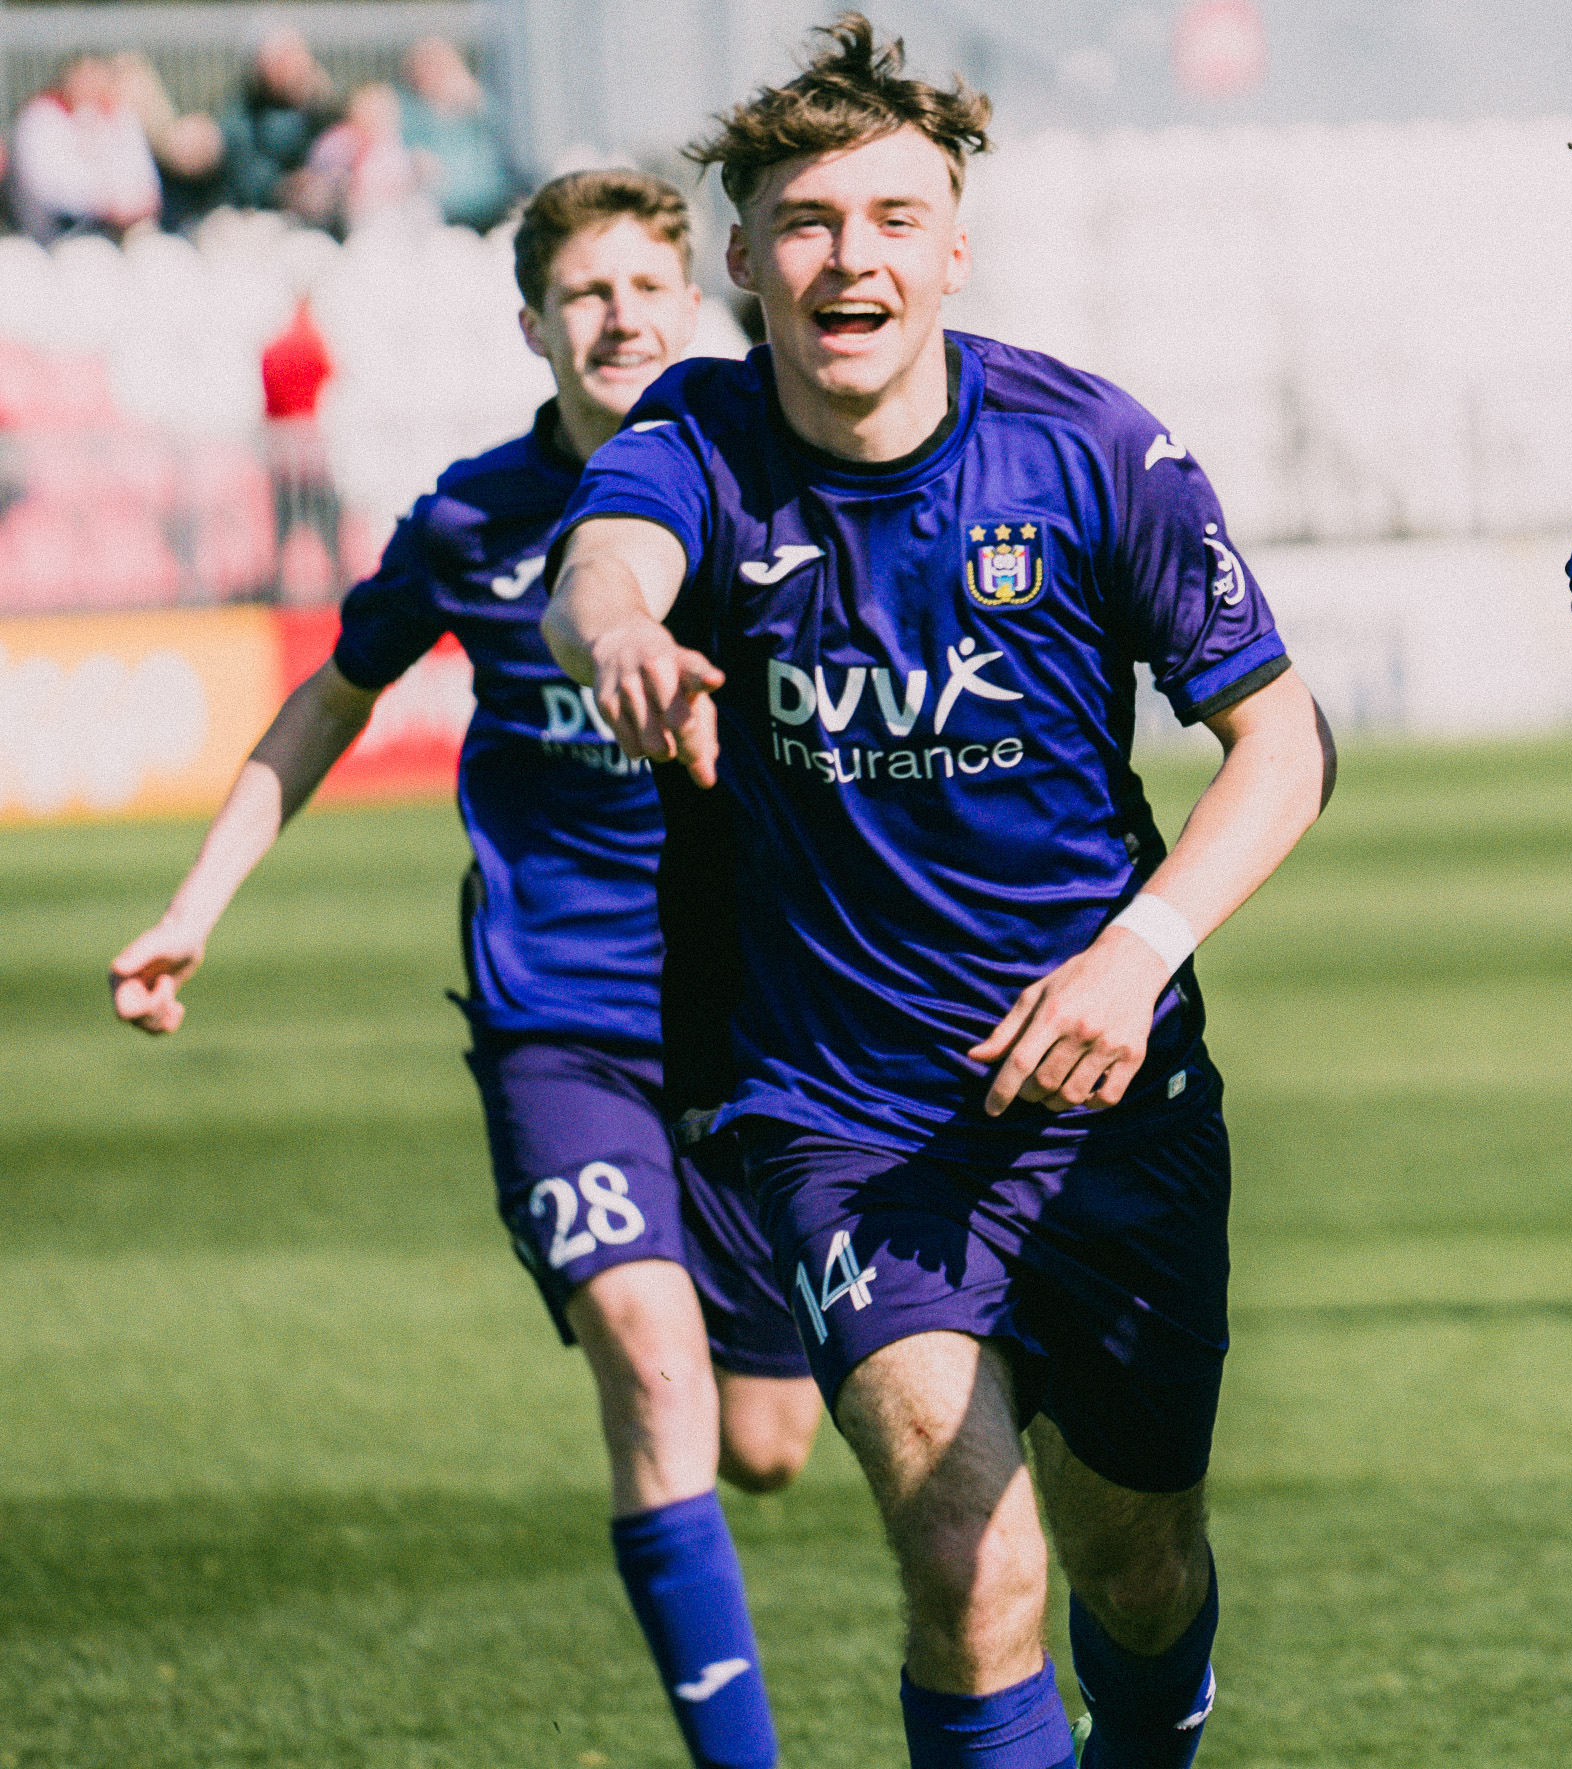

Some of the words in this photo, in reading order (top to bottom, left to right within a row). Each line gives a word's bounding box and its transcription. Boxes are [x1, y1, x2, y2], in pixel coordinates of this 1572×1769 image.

[771, 721, 1024, 784] insurance
[529, 1160, 646, 1269] 28
[796, 1230, 878, 1345] 14
